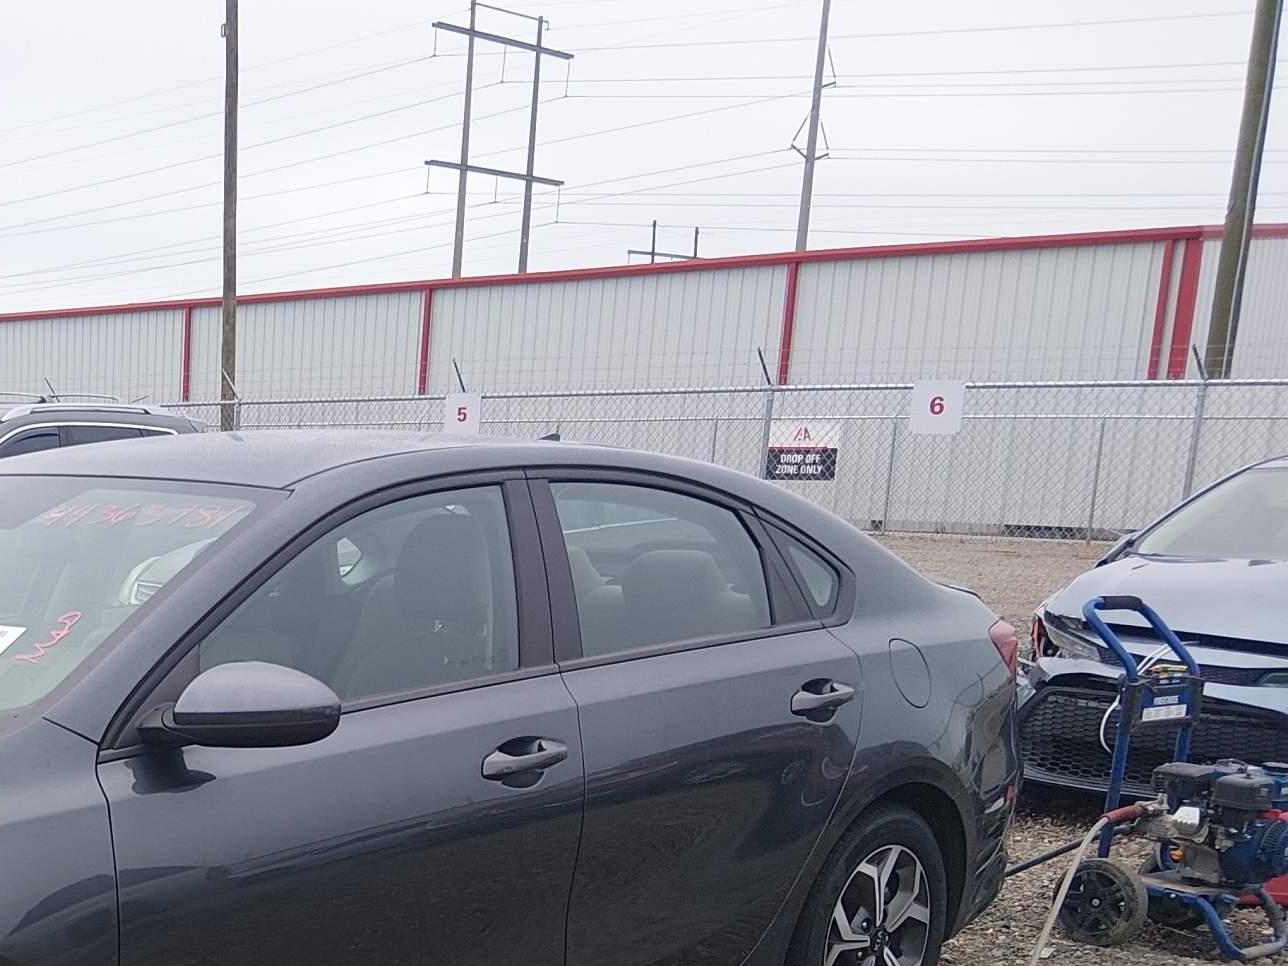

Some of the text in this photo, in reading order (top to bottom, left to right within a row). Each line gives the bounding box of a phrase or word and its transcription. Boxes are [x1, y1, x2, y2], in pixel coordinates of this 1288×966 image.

[929, 396, 945, 415] 6
[457, 406, 467, 423] 5
[780, 453, 821, 464] DROP OFF
[775, 464, 823, 475] ZONE ONLY
